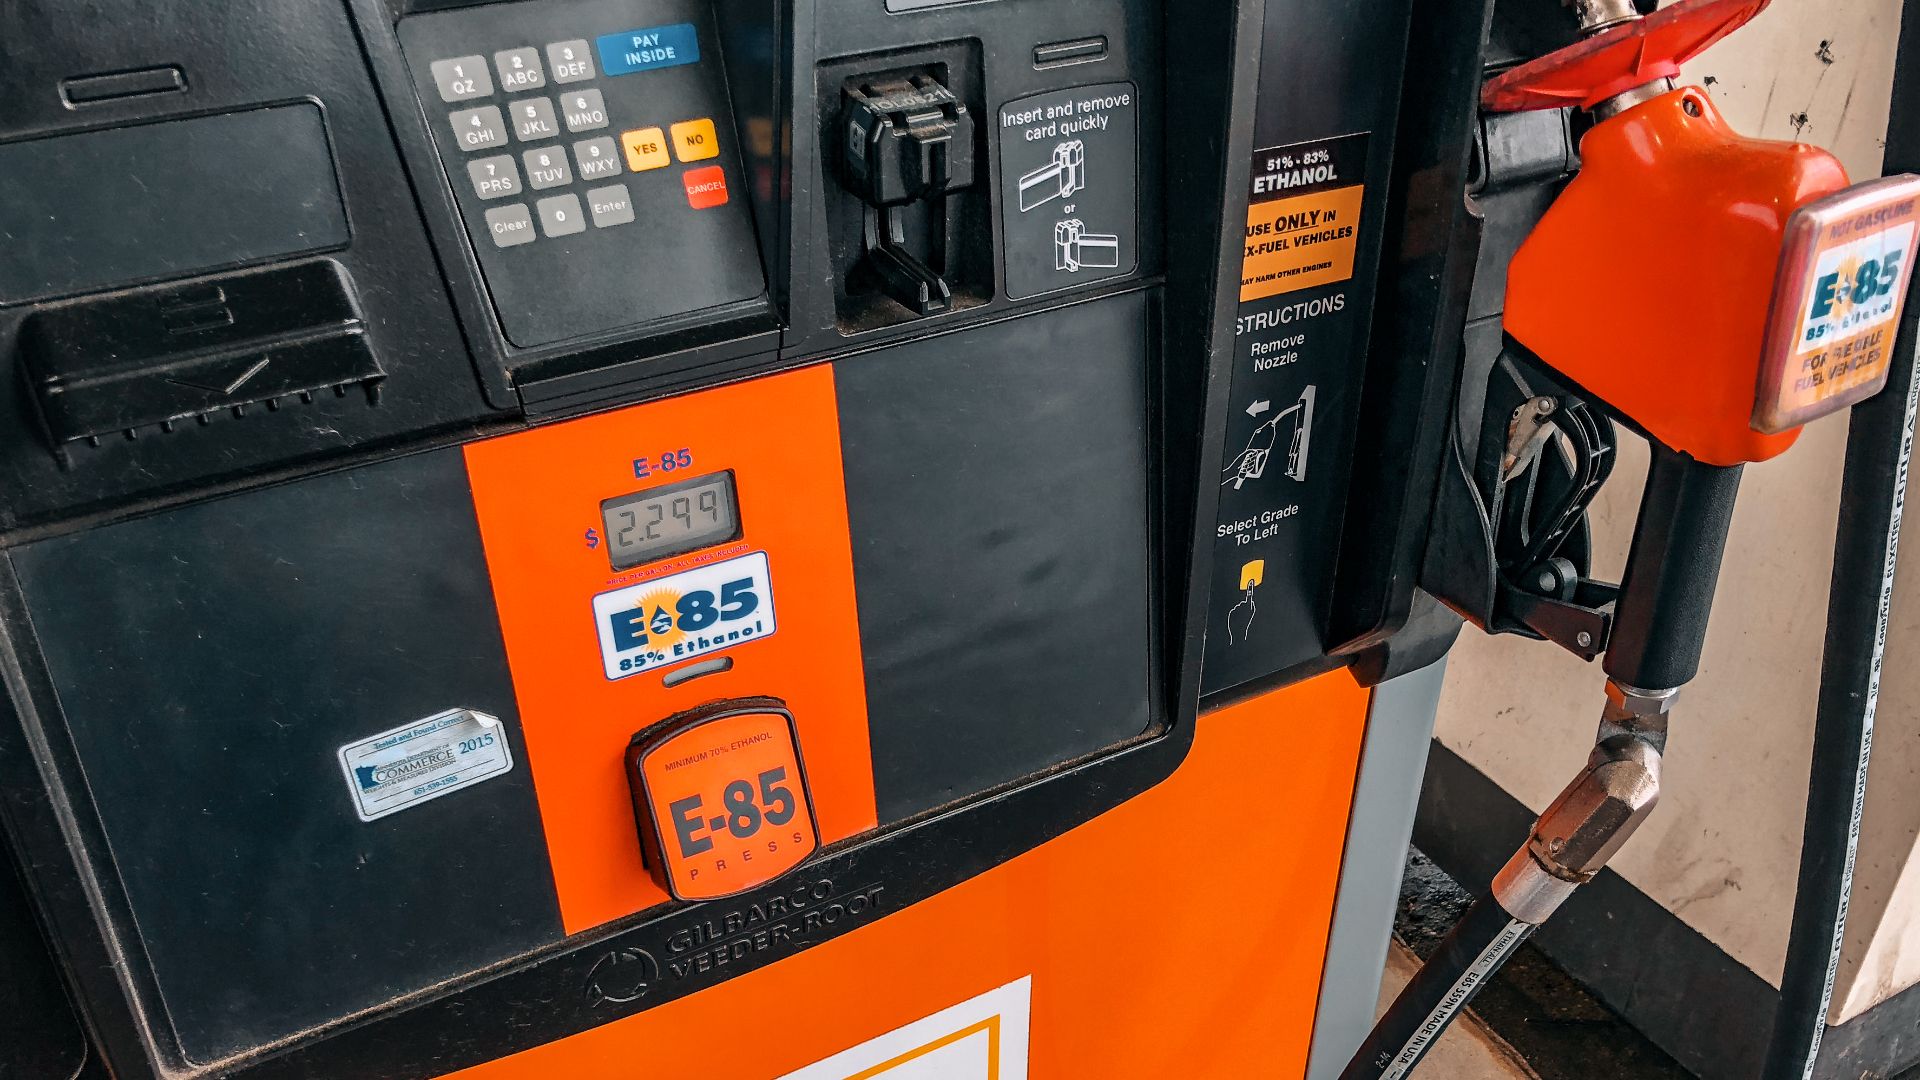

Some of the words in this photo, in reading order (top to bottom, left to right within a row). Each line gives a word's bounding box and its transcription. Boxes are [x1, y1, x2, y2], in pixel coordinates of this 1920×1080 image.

[632, 34, 660, 49] PAY
[512, 56, 523, 69] 2
[564, 49, 574, 61] 3
[625, 47, 676, 66] INSIDE
[455, 65, 464, 78] 1
[506, 70, 538, 86] ABC
[559, 62, 587, 78] DEF
[453, 80, 476, 95] QZ
[526, 106, 537, 118] 5
[576, 98, 587, 110] 6
[1003, 110, 1042, 128] Insert
[1046, 101, 1073, 120] and
[1077, 93, 1131, 113] remove
[471, 115, 481, 127] 4
[522, 120, 551, 135] JKL
[569, 111, 604, 127] MNO
[1025, 123, 1056, 142] card
[1061, 113, 1109, 137] quickly
[466, 129, 495, 146] GHI
[686, 134, 704, 146] NO
[590, 145, 600, 158] 9
[633, 142, 658, 156] YES
[540, 155, 551, 167] 8
[582, 158, 615, 175] WXY
[1266, 155, 1293, 171] 51%
[1303, 149, 1330, 165] 83%
[486, 164, 496, 176] 7
[535, 168, 564, 184] TUV
[481, 177, 512, 193] PRS
[1253, 164, 1338, 194] ETHANOL
[687, 181, 725, 196] CANCEL
[594, 199, 627, 214] Enter
[1064, 203, 1076, 214] or
[555, 210, 566, 222] 0
[1246, 222, 1271, 238] USE
[1274, 209, 1321, 233] ONLY
[1323, 210, 1337, 223] IN
[1854, 201, 1915, 232] GASOLINE
[494, 219, 528, 234] Clear
[1294, 226, 1353, 248] VEHICLES
[1256, 272, 1276, 284] HARM
[1277, 267, 1301, 279] OTHER
[1302, 261, 1332, 273] ENGINES
[1251, 334, 1305, 356] Remove
[1254, 351, 1298, 373] Nozzle
[633, 447, 692, 480] E-85
[618, 489, 718, 548] 2.299
[1217, 516, 1257, 538] Select
[1260, 504, 1299, 524] Grade
[1235, 534, 1250, 546] To
[1254, 524, 1279, 541] Left
[619, 650, 665, 671] 85%
[673, 621, 763, 657] Ethanol
[373, 736, 397, 750] Tested
[399, 732, 412, 742] and
[413, 724, 437, 737] Found
[437, 715, 464, 728] Correct
[1864, 727, 1873, 750] USA
[458, 733, 494, 755] 2015
[664, 752, 709, 772] MINIMUM
[709, 745, 729, 758] 70%
[730, 731, 773, 751] ETHANOL
[376, 749, 454, 782] COMMERCE
[669, 765, 796, 859] E-85
[690, 832, 803, 880] PRESS
[665, 878, 834, 953] GILBARCO
[669, 885, 885, 979] VEEDER-ROOT
[1461, 971, 1480, 988] E85
[1446, 987, 1465, 1010] 559N
[1422, 1009, 1450, 1036] MADE
[1413, 1035, 1427, 1050] IN
[1398, 1047, 1418, 1065] USA
